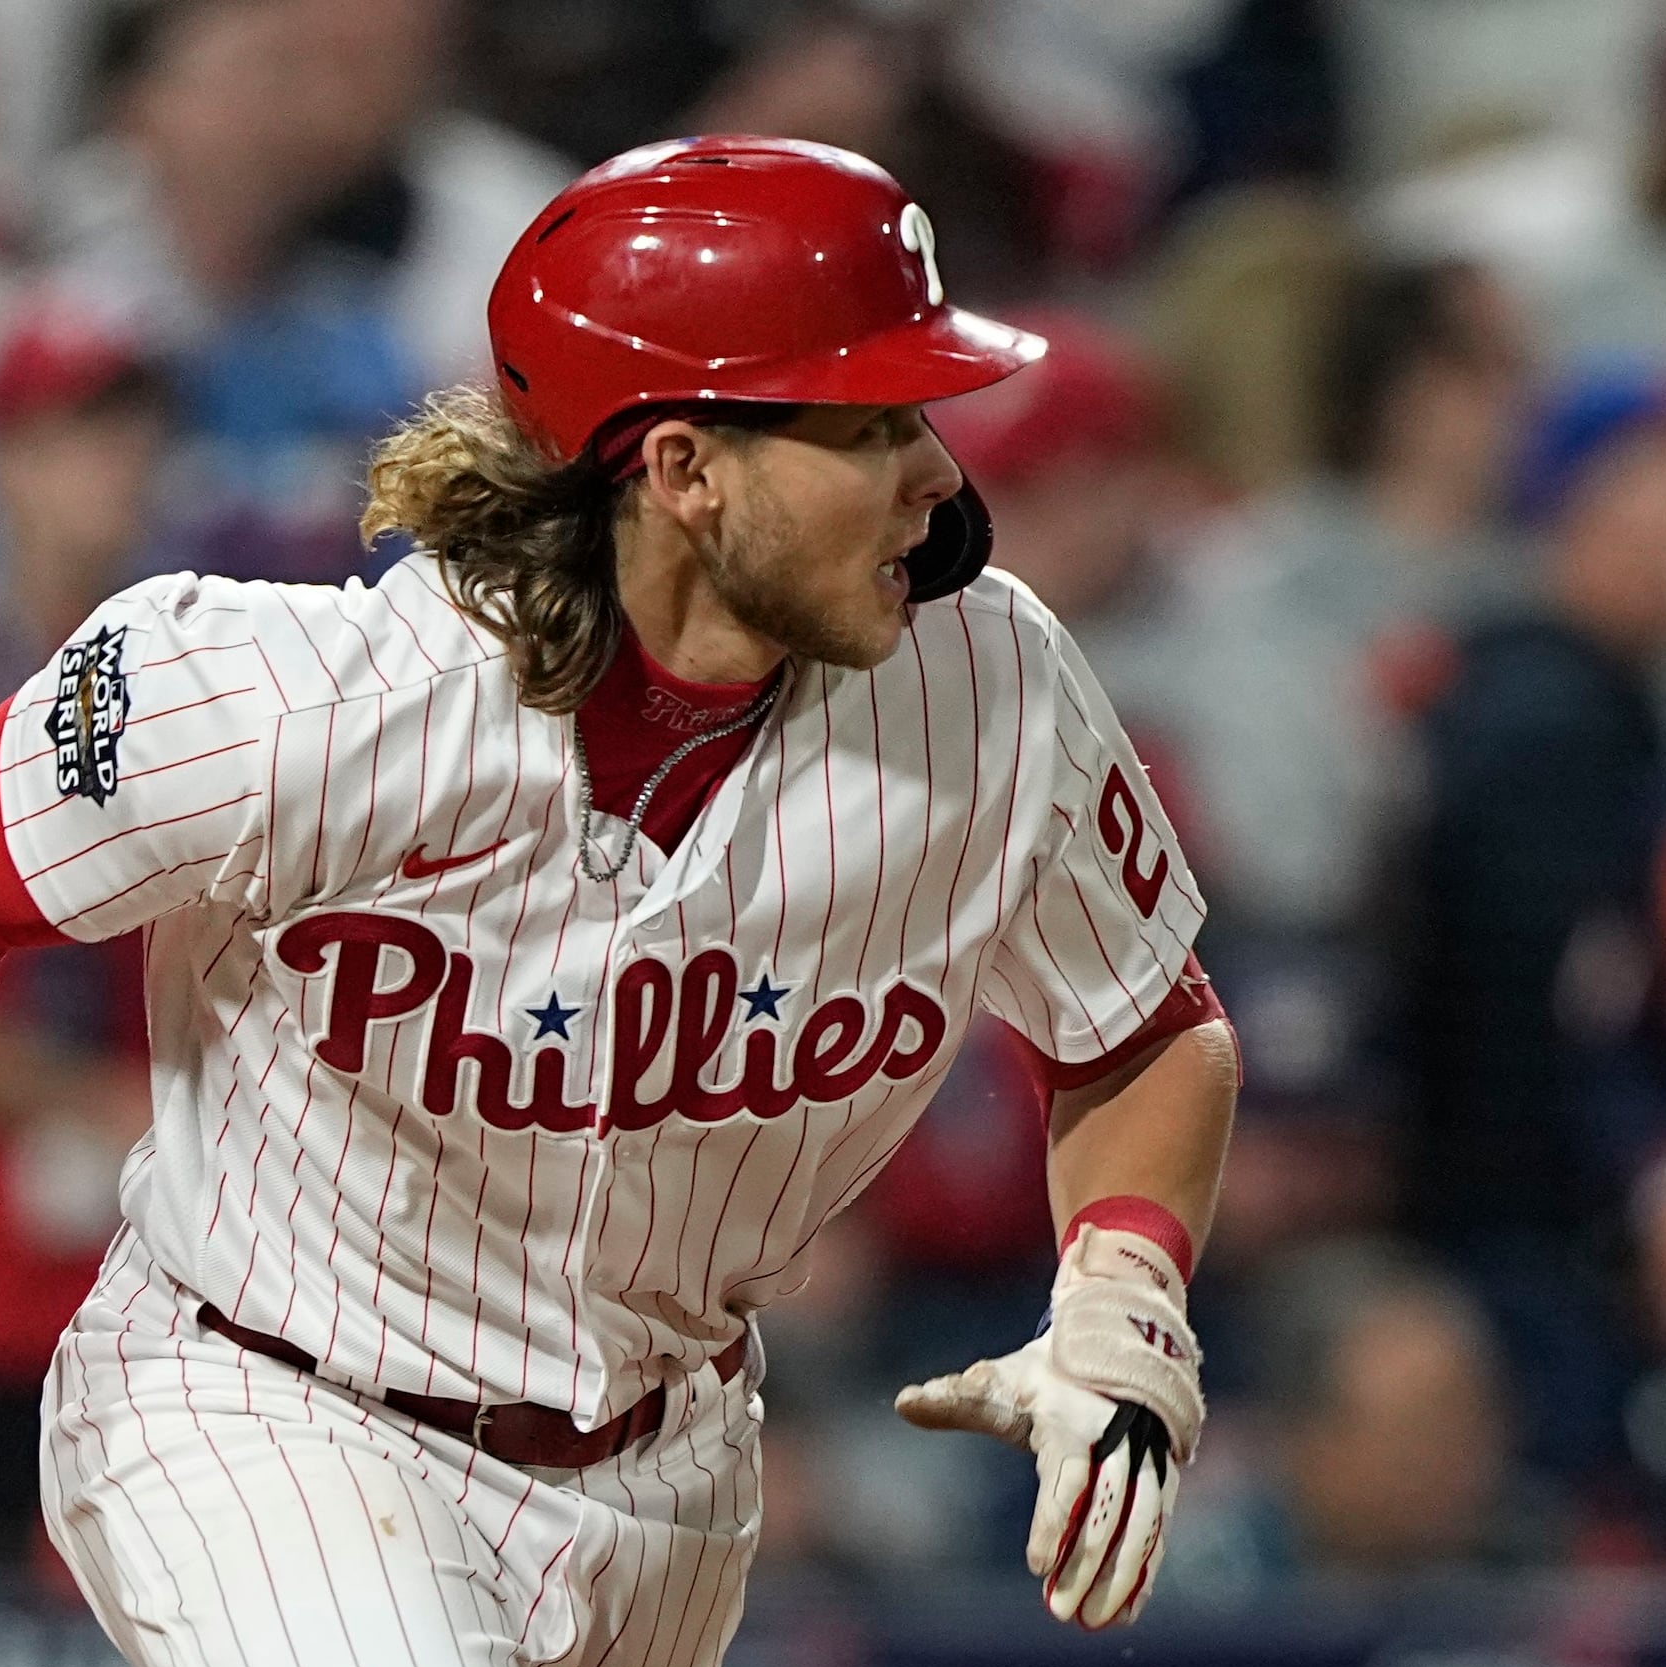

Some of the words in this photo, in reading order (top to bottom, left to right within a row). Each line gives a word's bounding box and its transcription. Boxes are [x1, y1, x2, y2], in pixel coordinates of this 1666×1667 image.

[57, 652, 84, 791] SERIES
[92, 630, 124, 791] WORLD
[273, 910, 949, 1142] Phillies
